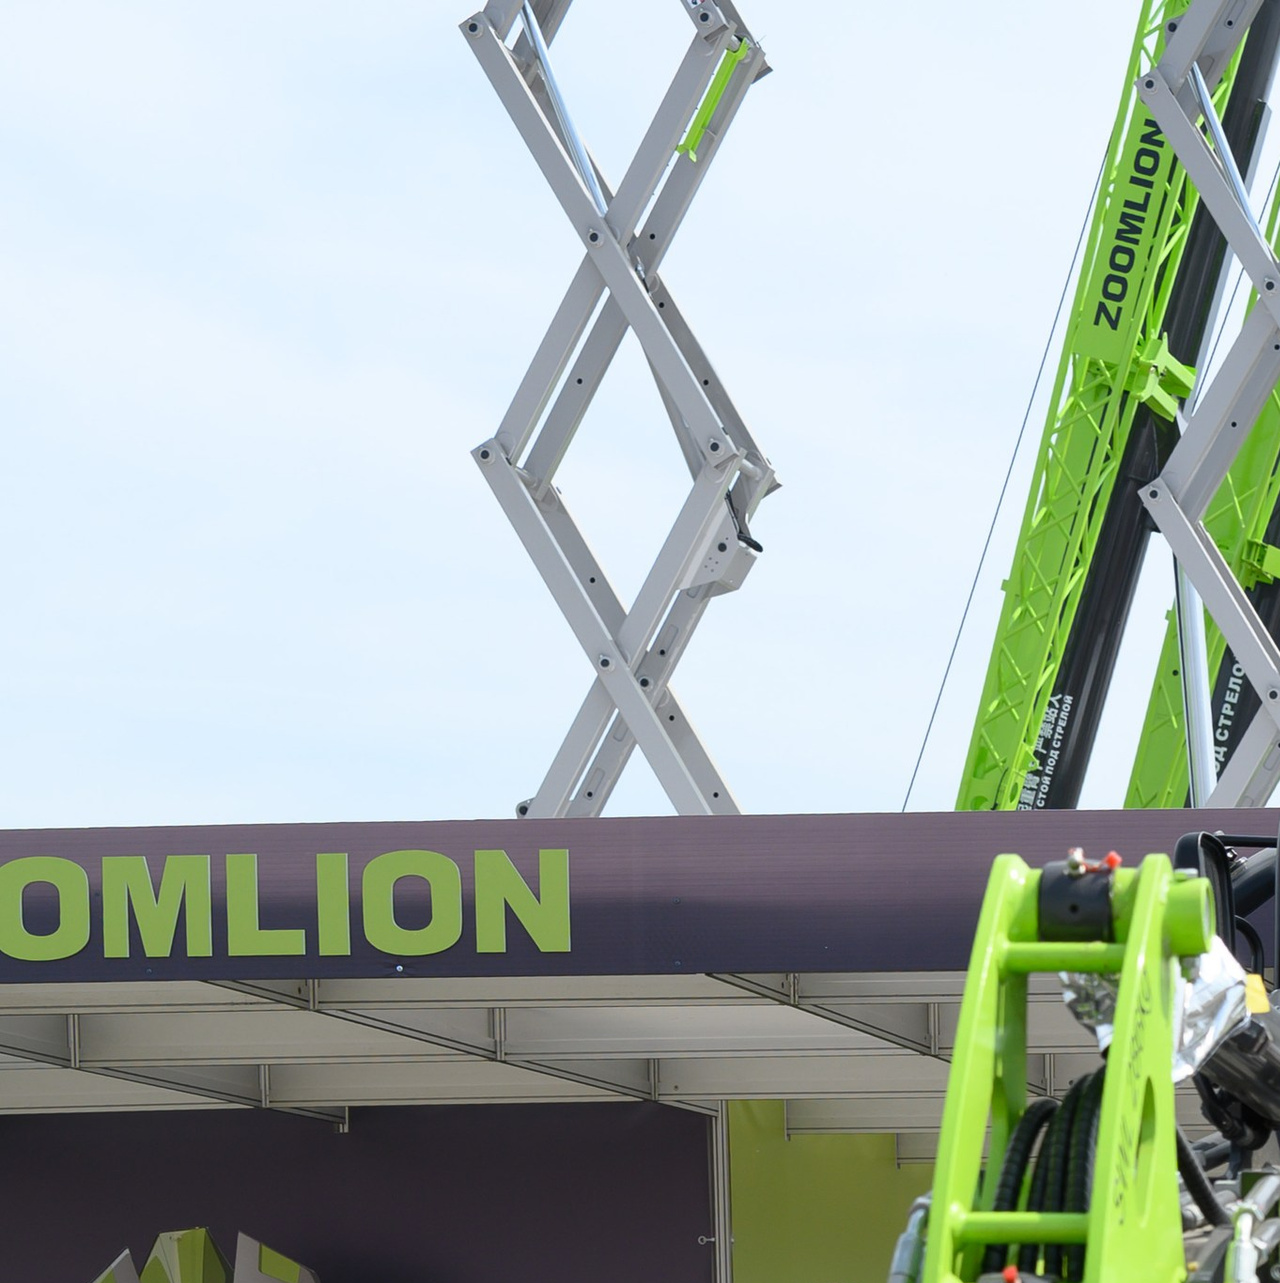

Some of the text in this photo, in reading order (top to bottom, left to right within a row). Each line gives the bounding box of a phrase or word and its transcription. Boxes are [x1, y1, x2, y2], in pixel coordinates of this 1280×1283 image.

[1093, 118, 1166, 331] ZOOMLION
[1036, 694, 1074, 808] СТОЙ ПОД СТРЕЛОЙ
[1215, 662, 1245, 742] СТРЕЛО
